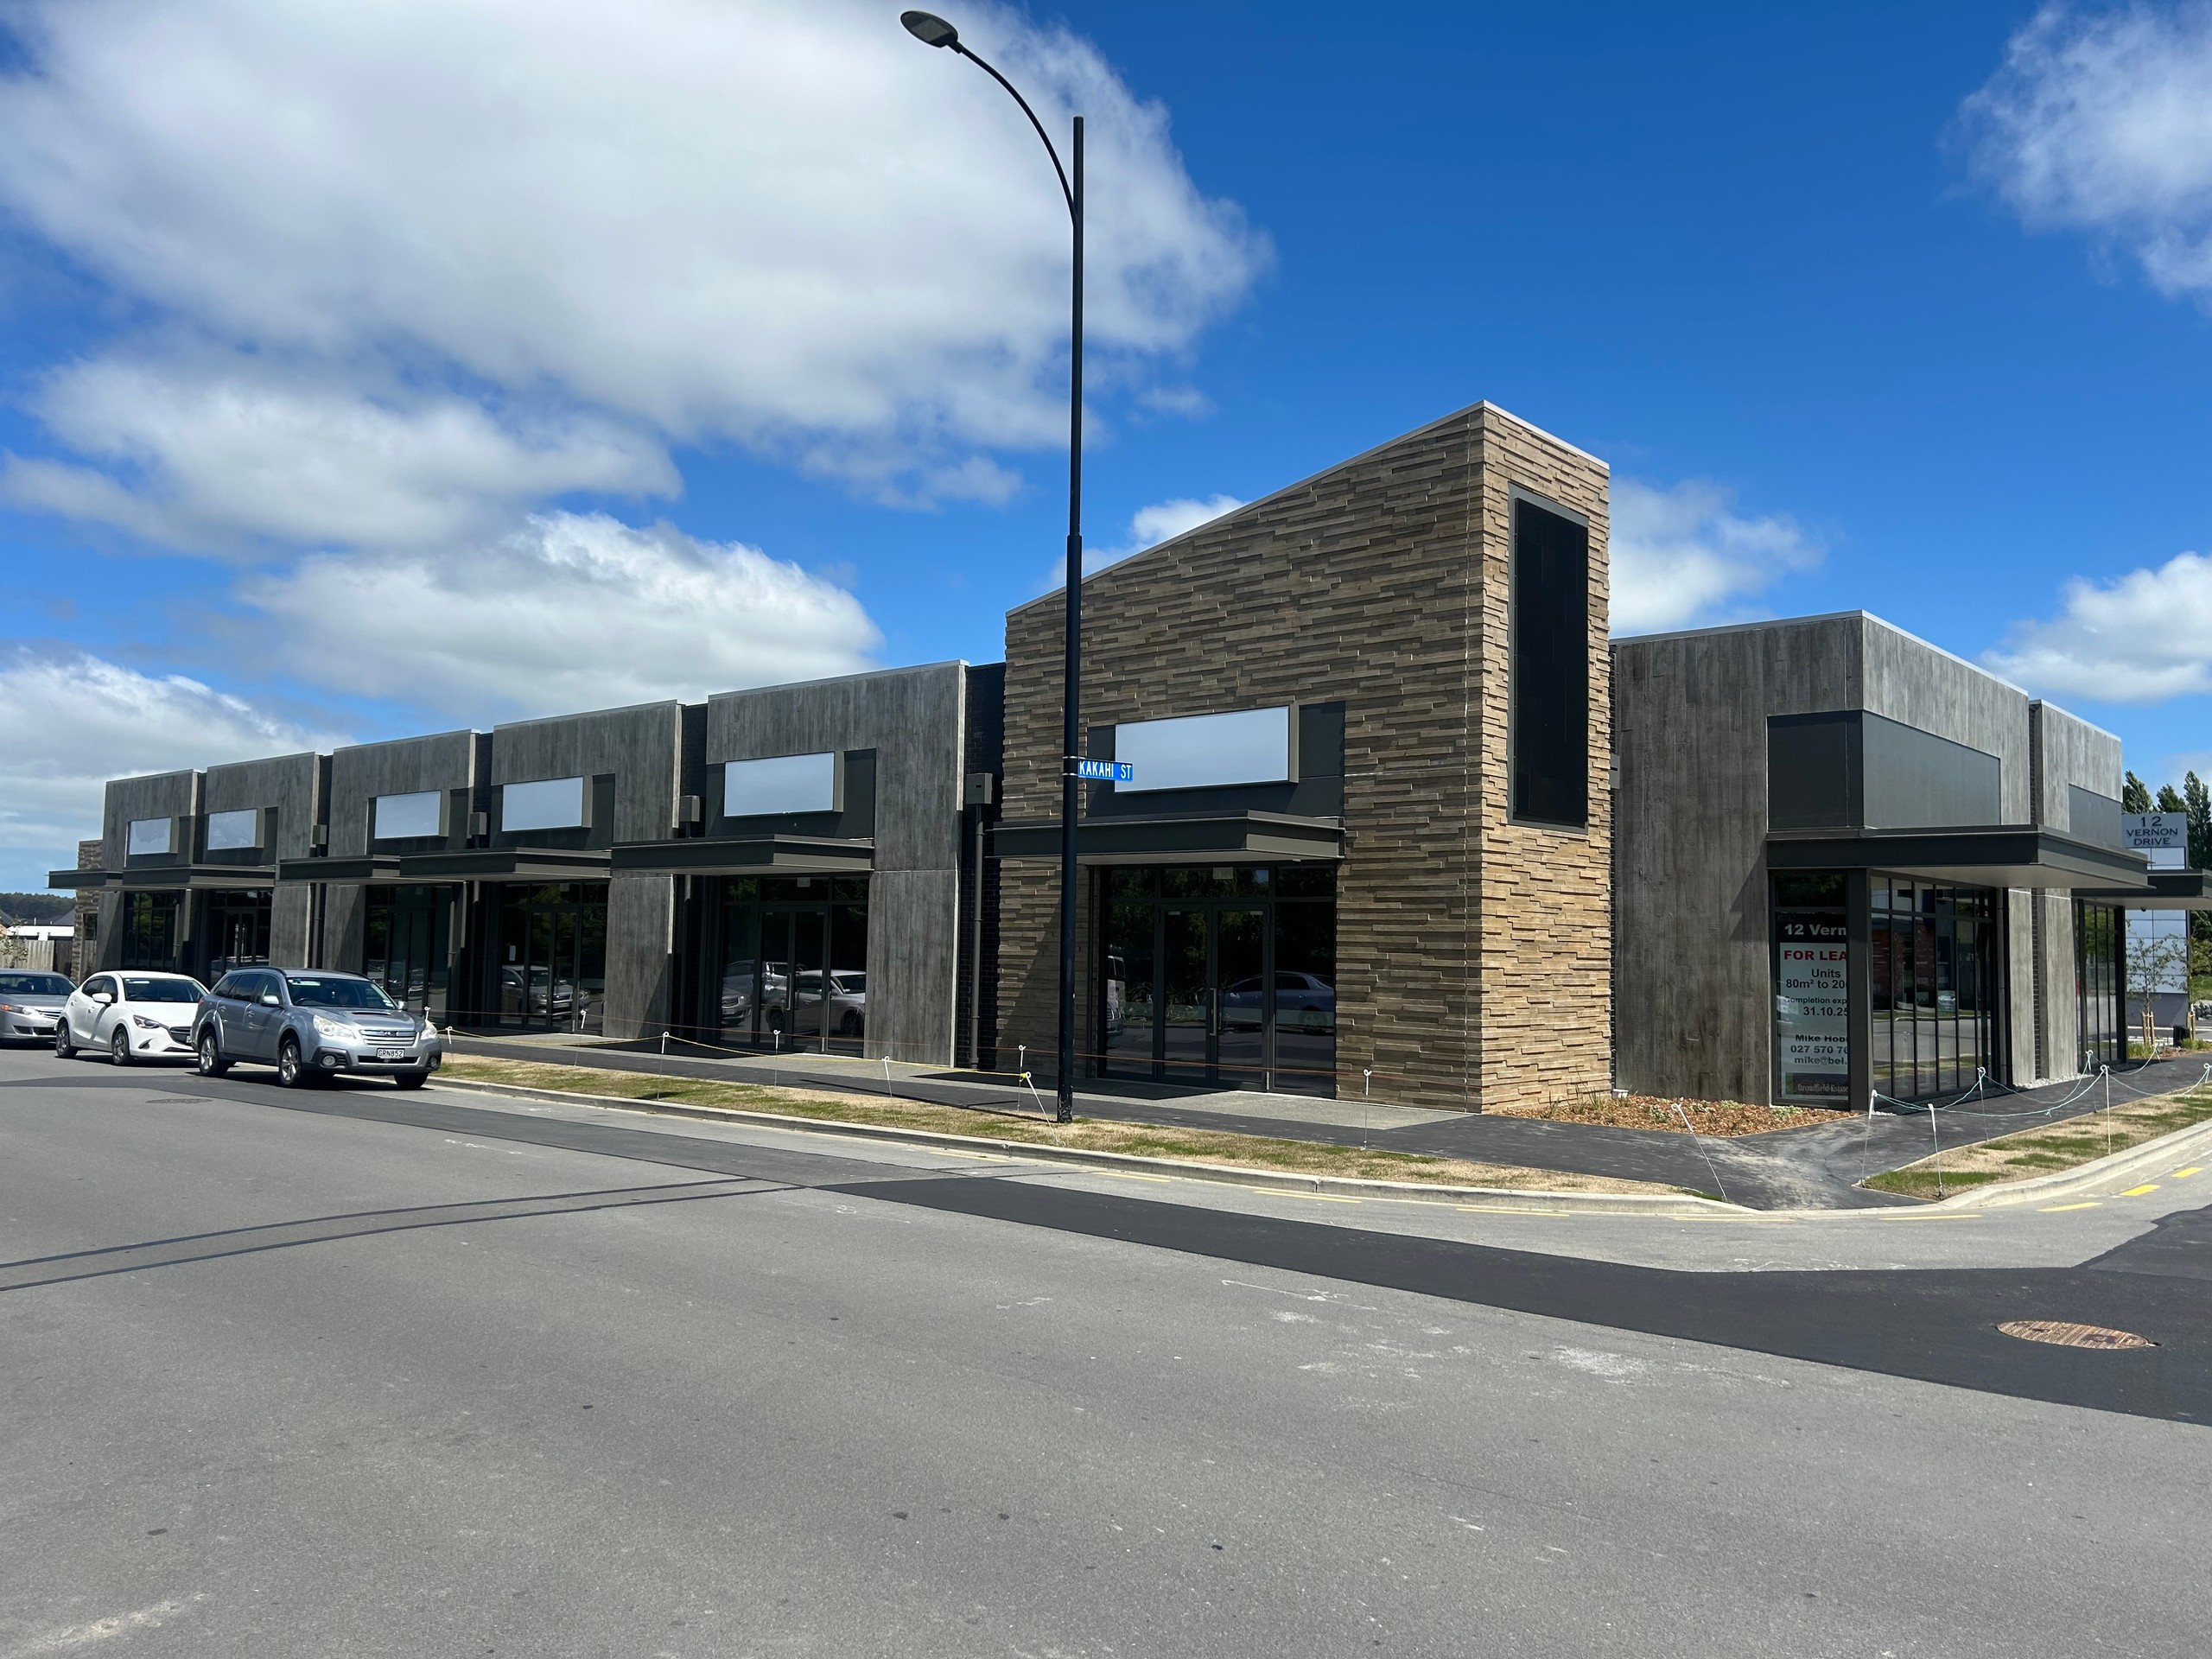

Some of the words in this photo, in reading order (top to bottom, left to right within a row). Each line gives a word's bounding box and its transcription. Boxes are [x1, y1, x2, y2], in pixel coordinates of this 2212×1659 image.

[1079, 760, 1114, 778] KAKAHI
[1121, 764, 1131, 779] ST
[2141, 816, 2162, 827] 12
[2126, 828, 2177, 836] VERNON
[1784, 924, 1804, 935] 12
[1808, 924, 1847, 936] Vern
[1783, 950, 1815, 960] FOR
[1811, 969, 1841, 978] Units
[1817, 980, 1829, 988] to
[1832, 980, 1847, 989] 20
[1814, 1046, 1834, 1054] 570
